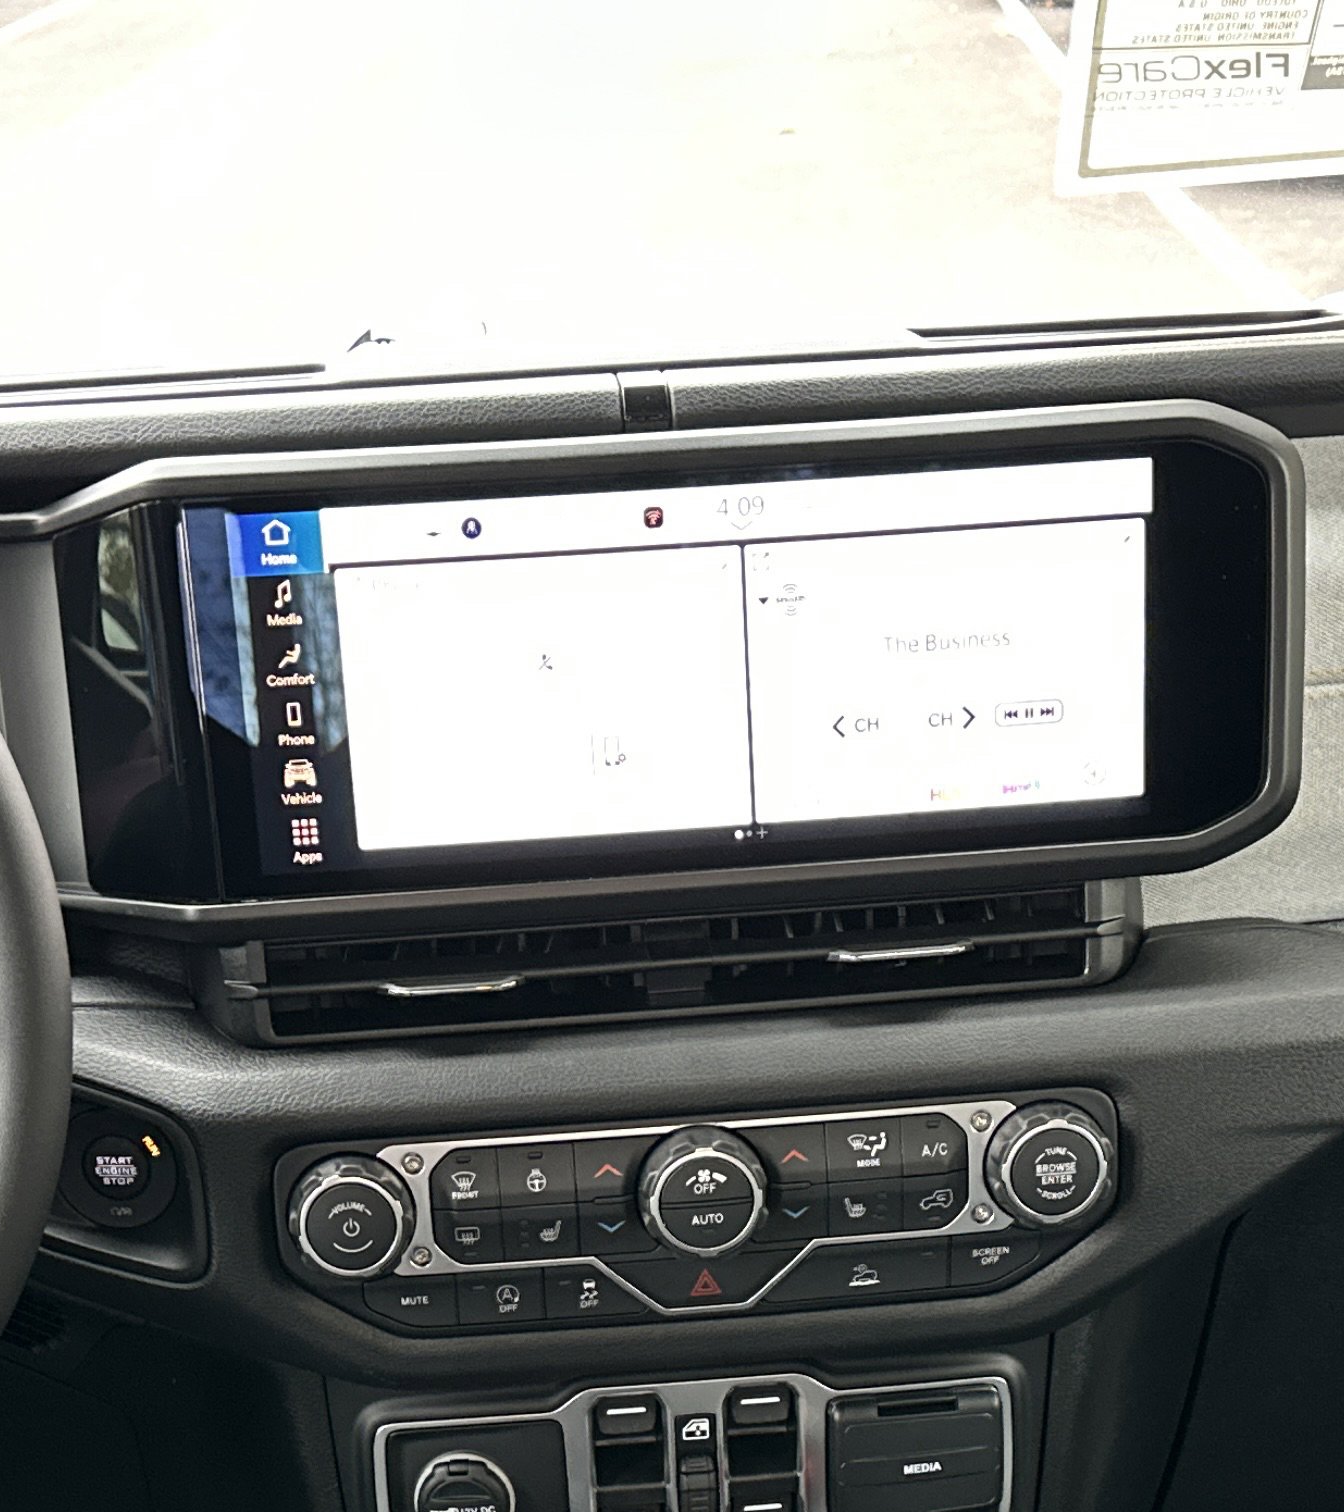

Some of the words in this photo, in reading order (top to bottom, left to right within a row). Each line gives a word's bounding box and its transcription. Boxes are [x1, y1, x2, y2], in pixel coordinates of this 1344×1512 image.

[260, 553, 297, 566] Home
[266, 613, 303, 626] Media
[883, 634, 919, 653] The
[925, 631, 1012, 652] Business
[266, 673, 315, 687] Comfort
[854, 718, 880, 733] CH
[928, 713, 954, 728] CH
[278, 734, 315, 747] Phone
[281, 792, 323, 806] Vehicle
[293, 852, 324, 865] Apps
[921, 1142, 948, 1157] A/C
[95, 1156, 133, 1165] START
[857, 1158, 881, 1168] MODE
[94, 1166, 138, 1176] ENGINE
[1036, 1162, 1077, 1173] BROWSE
[103, 1177, 135, 1185] STOP
[1041, 1175, 1073, 1185] ENTER
[452, 1190, 479, 1200] FRONT
[693, 1183, 717, 1195] OFF
[331, 1201, 365, 1214] VOLUME
[691, 1212, 724, 1226] AUTO
[972, 1246, 1010, 1258] SCREEN
[981, 1255, 1001, 1266] OFF
[400, 1295, 430, 1306] MUTE
[580, 1299, 599, 1309] OFF
[499, 1304, 518, 1314] OFF
[903, 1461, 943, 1475] MEDIA
